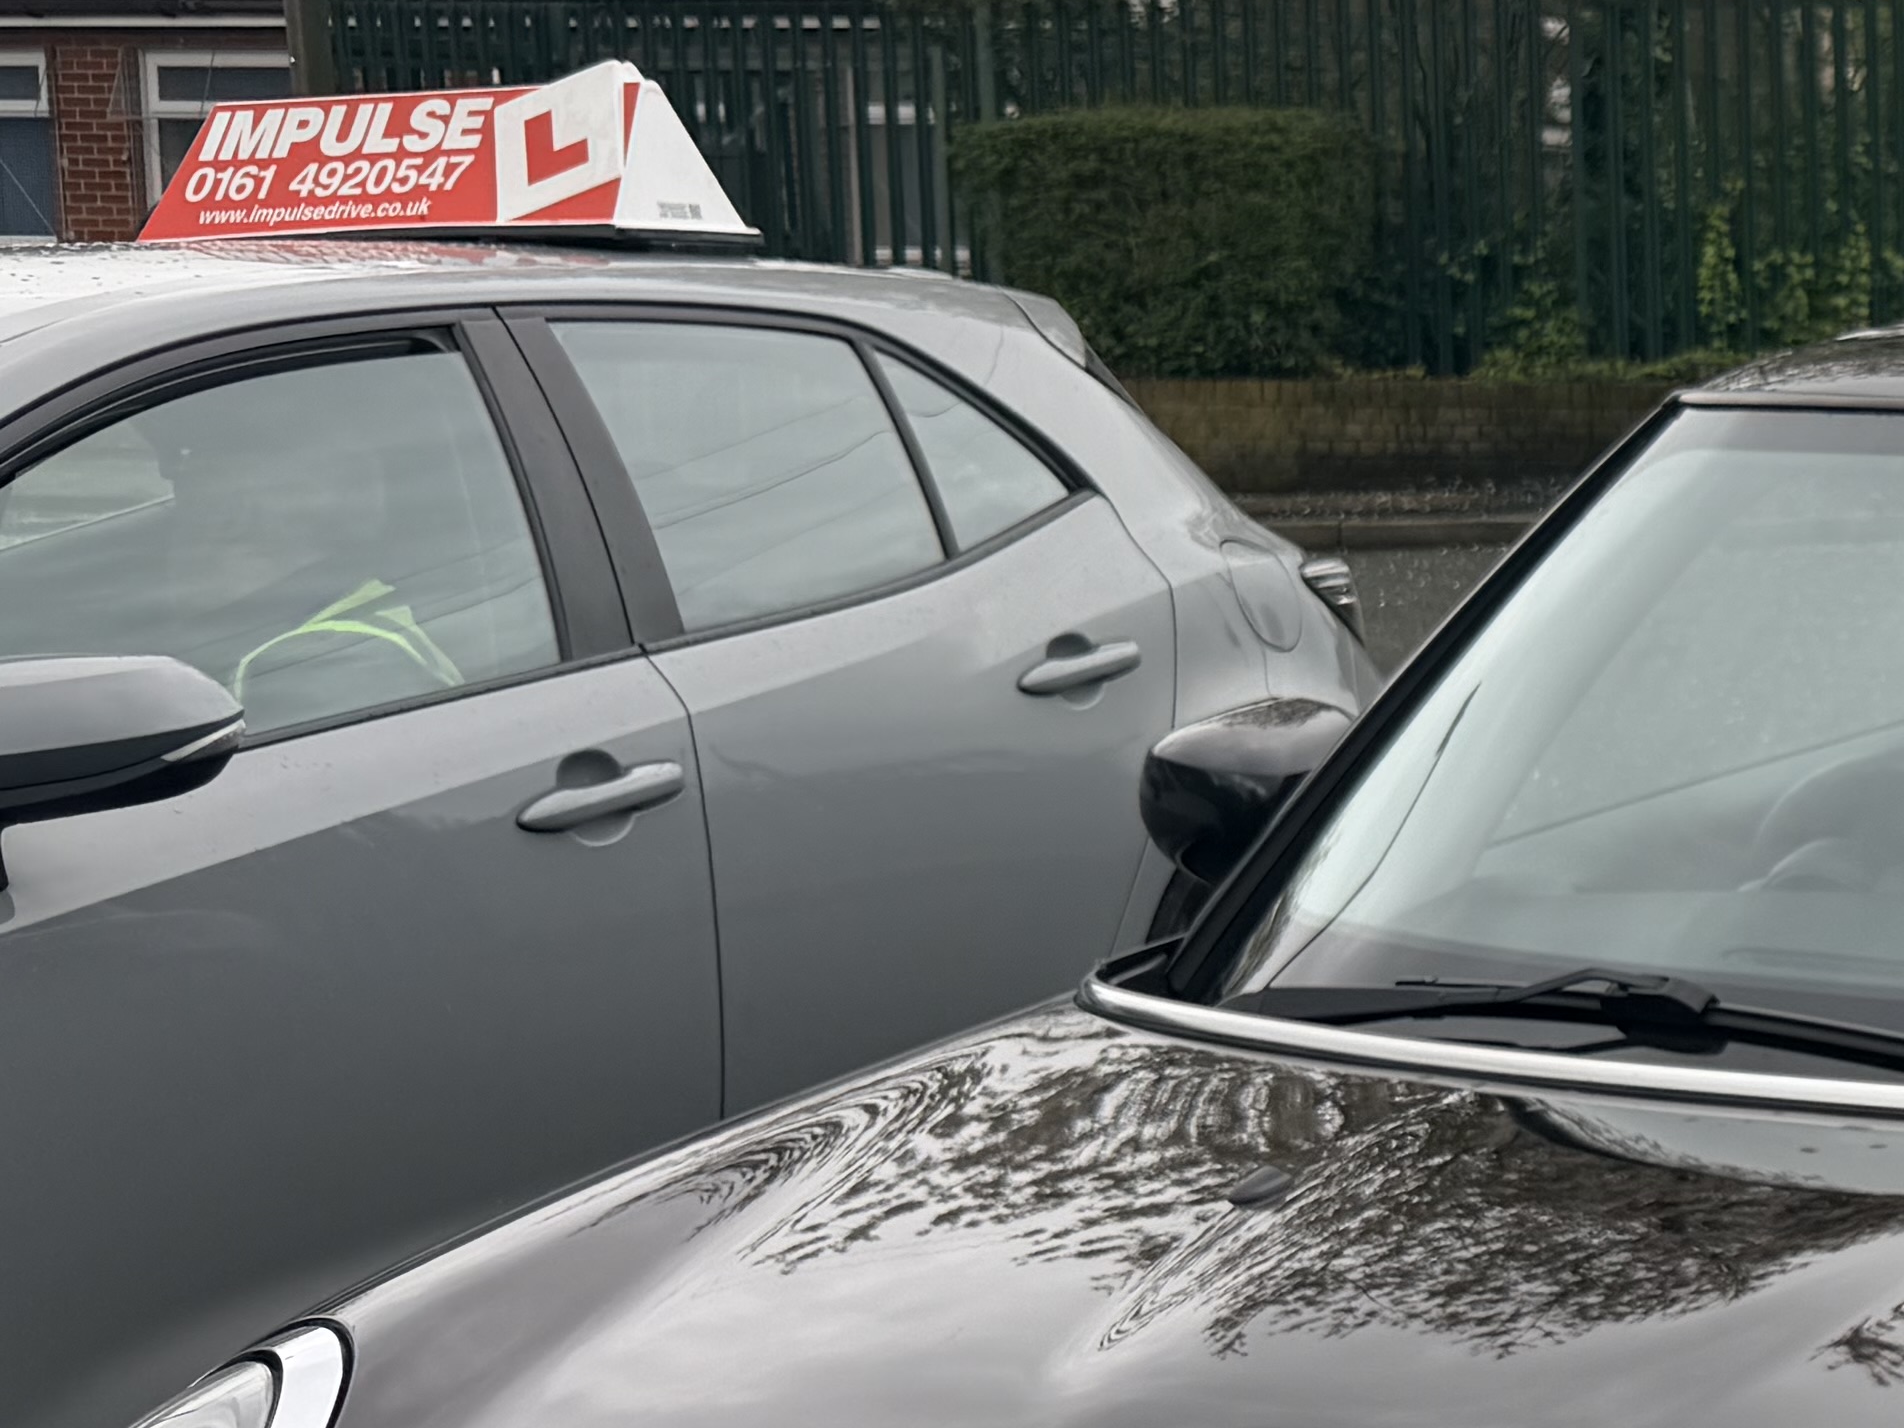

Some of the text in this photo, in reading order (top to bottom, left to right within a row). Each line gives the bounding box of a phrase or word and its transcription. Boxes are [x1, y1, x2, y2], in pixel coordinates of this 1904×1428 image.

[198, 97, 494, 162] IMPULSE
[185, 155, 474, 203] 0161 4920547
[198, 197, 432, 227] www.impulsedrive.co.uk
